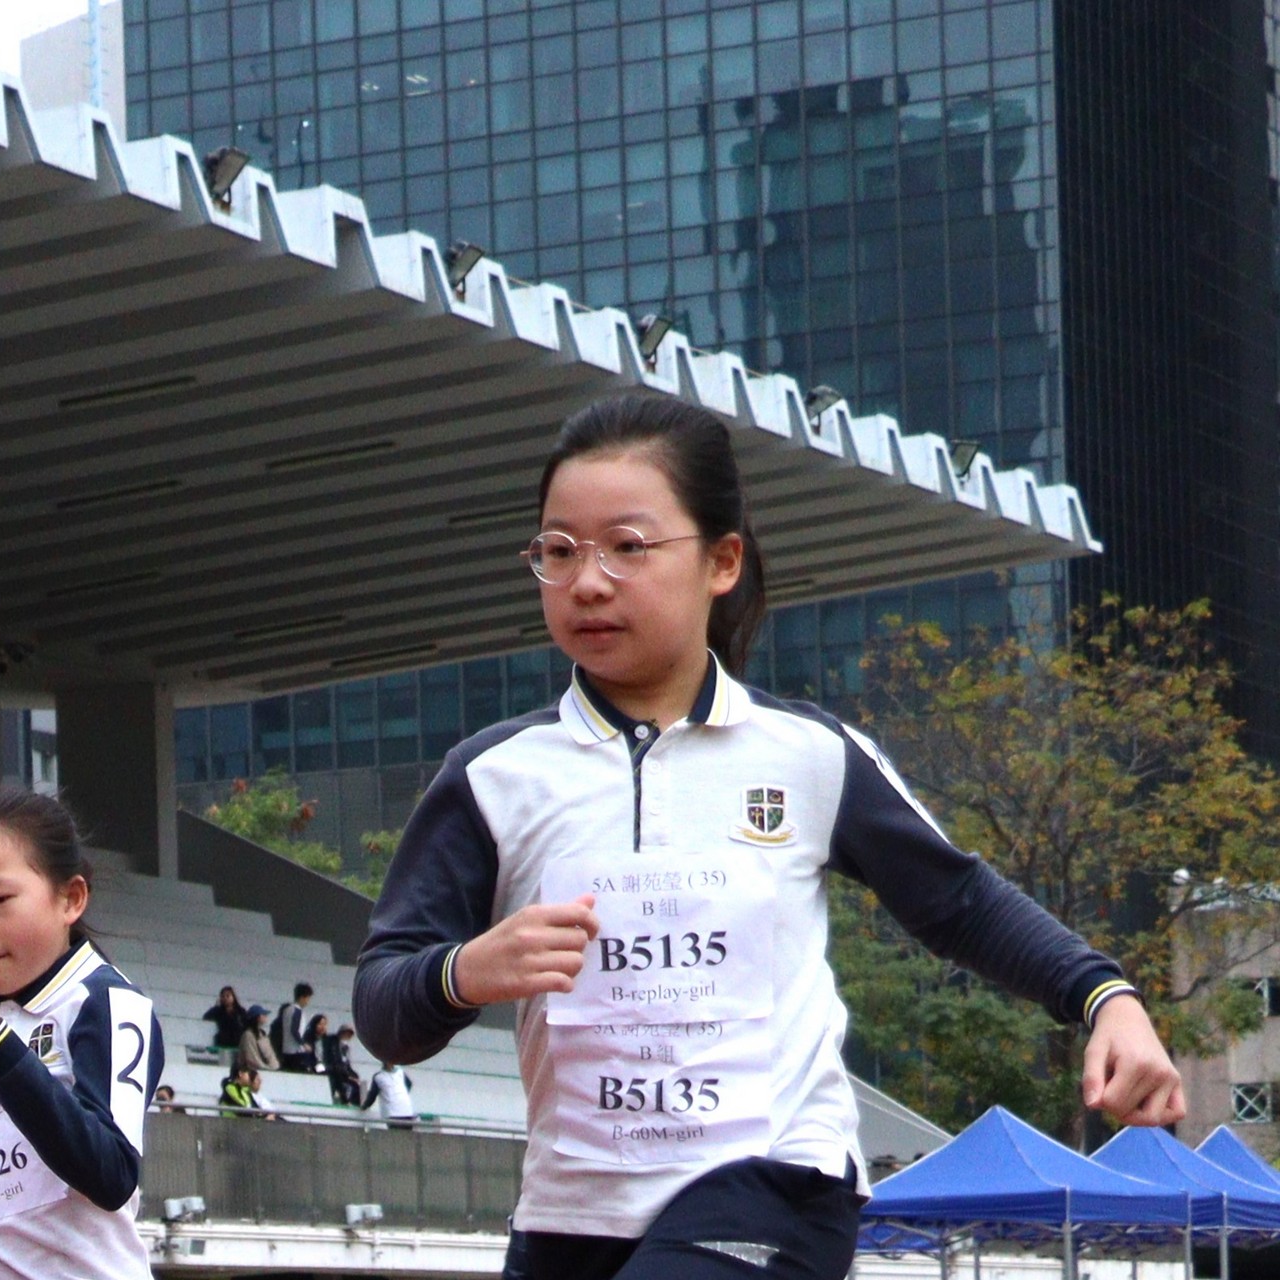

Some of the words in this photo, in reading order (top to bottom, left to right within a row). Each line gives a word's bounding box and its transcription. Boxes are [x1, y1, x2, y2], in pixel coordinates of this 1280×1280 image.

[592, 877, 616, 893] 5A
[642, 901, 654, 916] B
[659, 898, 679, 917] 組
[598, 930, 728, 973] B5135
[611, 980, 716, 1005] B-replay-girl
[116, 1021, 145, 1095] 2
[640, 1045, 652, 1061] B
[597, 1075, 721, 1113] B5135
[612, 1125, 705, 1142] B-60M-girl
